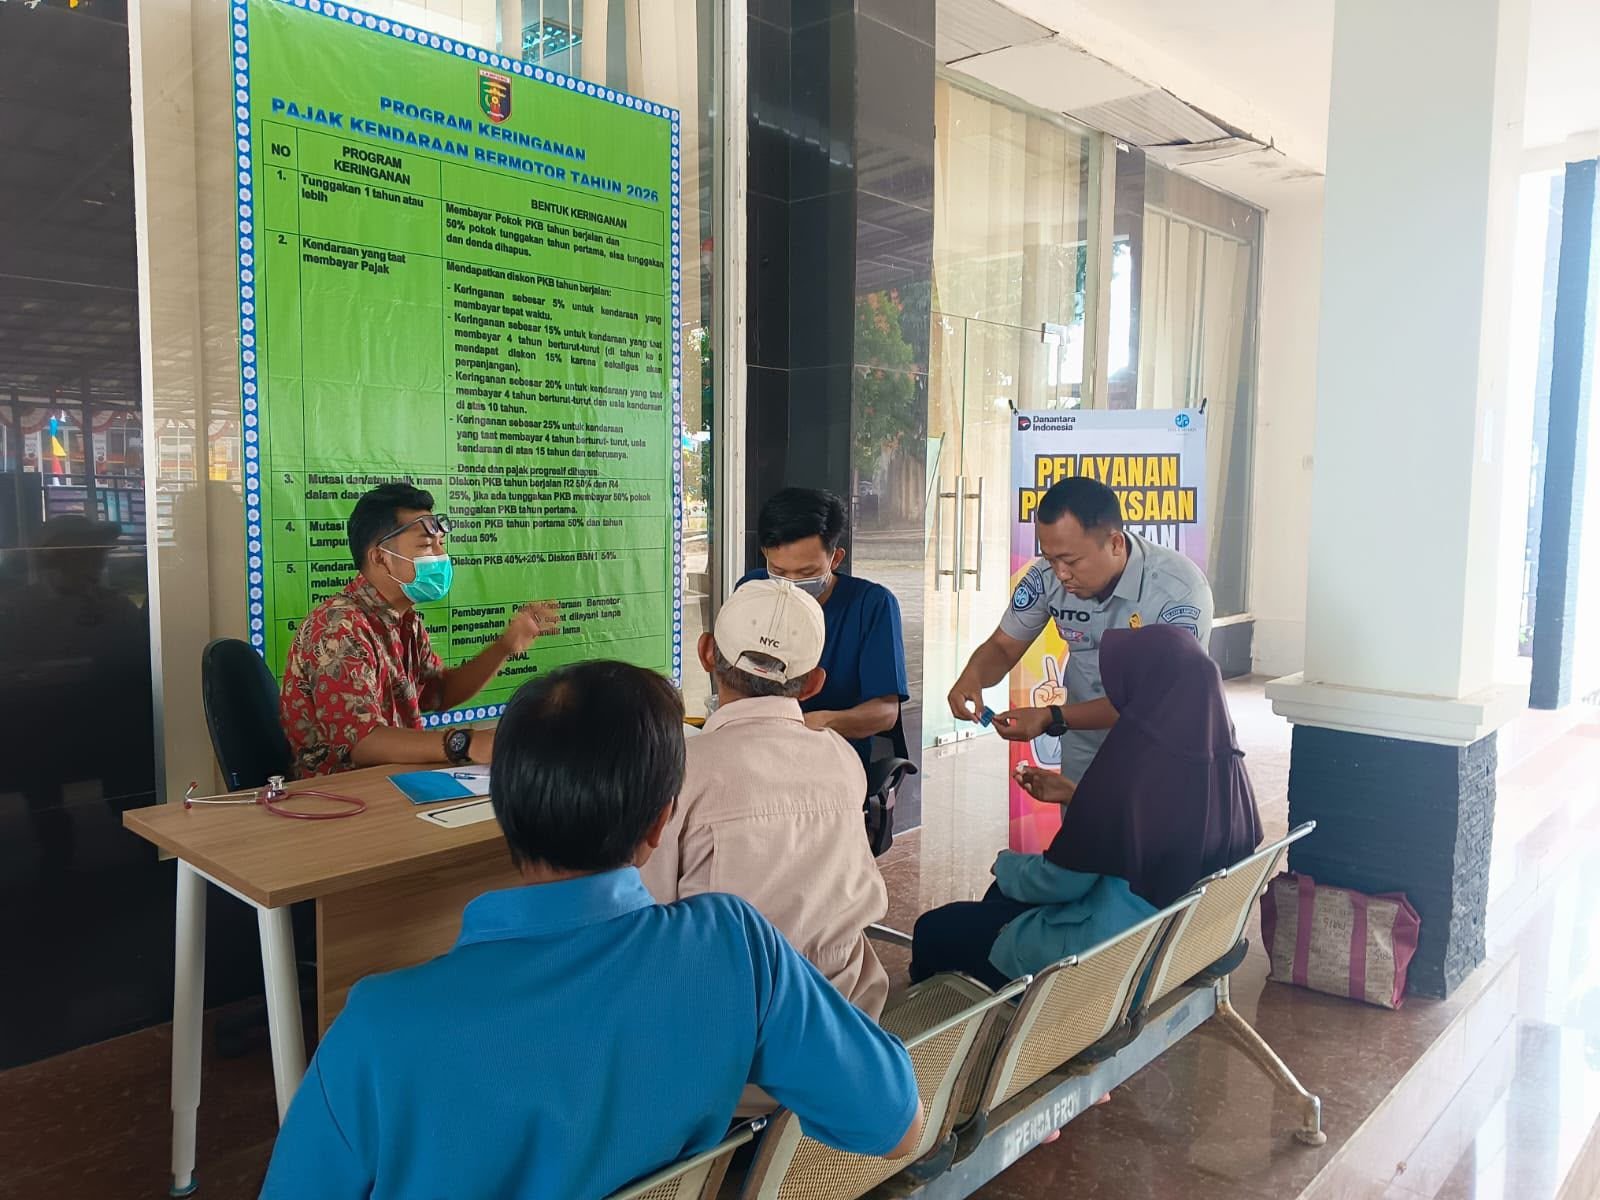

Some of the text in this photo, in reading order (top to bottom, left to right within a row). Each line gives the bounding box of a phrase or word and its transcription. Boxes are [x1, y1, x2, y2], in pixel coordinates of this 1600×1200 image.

[380, 96, 586, 161] PROGRAM KERINGANAN
[271, 143, 291, 157] NO
[272, 98, 658, 202] PAJAK KENDARAAN BERMOTOR TAHUN 2026
[342, 146, 402, 169] PROGRAM
[277, 170, 286, 180] 1.
[334, 159, 410, 185] KERINGANAN
[302, 174, 423, 207] Tunggakan 1 tahun atau
[302, 188, 328, 202] lebih
[531, 200, 627, 229] BENTUK KERINGANAN
[446, 203, 620, 246] Membayar Pokok PKB tahun berjalan dan
[278, 235, 287, 244] 2.
[447, 219, 606, 258] 50% pokok tunggakan tahun pertama,
[447, 234, 531, 257] dan denda dihapus.
[303, 238, 405, 263] Kendaraan yang taat
[303, 253, 389, 274] membayar Pajak
[447, 262, 505, 280] Mendapatkan
[507, 273, 535, 284] diskon
[537, 277, 554, 286] PKB
[556, 280, 578, 291] tahun
[454, 283, 504, 299] Keringanan
[512, 294, 545, 306] sebesar
[553, 299, 565, 309] 5%
[572, 303, 594, 313] untuk
[601, 306, 638, 320] kendaraan
[454, 300, 523, 317] membayar tepat
[455, 313, 505, 328] Keringanan
[508, 320, 541, 333] sebesar
[544, 325, 561, 336] 15%
[564, 329, 586, 339] untuk
[455, 329, 501, 343] membayar
[507, 333, 512, 343] 4
[518, 336, 542, 347] tahun
[455, 343, 498, 357] mendapat
[508, 348, 536, 360] diskon
[546, 353, 562, 363] 15%
[456, 357, 520, 373] perpanjangan).
[456, 371, 506, 386] Keringanan
[509, 378, 542, 388] sebesar
[545, 380, 561, 390] 20%
[565, 382, 587, 392] untuk
[456, 387, 536, 401] membayar 4 tahun
[456, 401, 527, 414] di 10 tahun.
[457, 415, 507, 428] Keringanan
[509, 417, 541, 429] sebesar
[544, 419, 560, 430] 25%
[457, 430, 478, 441] yang
[500, 432, 542, 444] membayar
[545, 433, 549, 443] 4
[552, 434, 574, 444] tahun
[505, 444, 513, 455] di
[516, 446, 533, 455] atas
[536, 446, 545, 456] 15
[547, 447, 570, 457] tahun
[458, 464, 486, 474] Denda
[488, 465, 504, 474] dan
[506, 465, 528, 476] pajak
[284, 474, 293, 484] 3.
[309, 474, 442, 485] Mutasi nama
[450, 477, 480, 487] Diskon
[483, 478, 502, 486] PKB
[504, 478, 527, 487] tahun
[564, 479, 574, 488] R2
[609, 480, 618, 489] R4
[306, 490, 337, 500] dalam
[450, 491, 471, 501] 25%,
[491, 491, 506, 500] ada
[509, 492, 552, 504] tunggakan
[554, 492, 571, 501] PKB
[450, 505, 496, 517] tunggakan
[498, 505, 517, 514] PKB
[519, 505, 542, 514] tahun
[286, 522, 295, 532] 4.
[310, 522, 344, 532] Mutasi
[451, 519, 481, 530] Diskon
[485, 519, 503, 528] PKB
[507, 519, 530, 528] tahun
[533, 519, 565, 530] pertama
[568, 518, 584, 527] 50%
[587, 518, 600, 527] dan
[450, 533, 497, 543] kedua 50%
[452, 556, 482, 566] Diskon
[484, 555, 503, 565] PKB
[287, 564, 296, 573] 5.
[452, 607, 505, 618] Pembayaran
[288, 621, 297, 630] 6.
[452, 621, 504, 634] pengesahan
[760, 636, 780, 648] NYC
